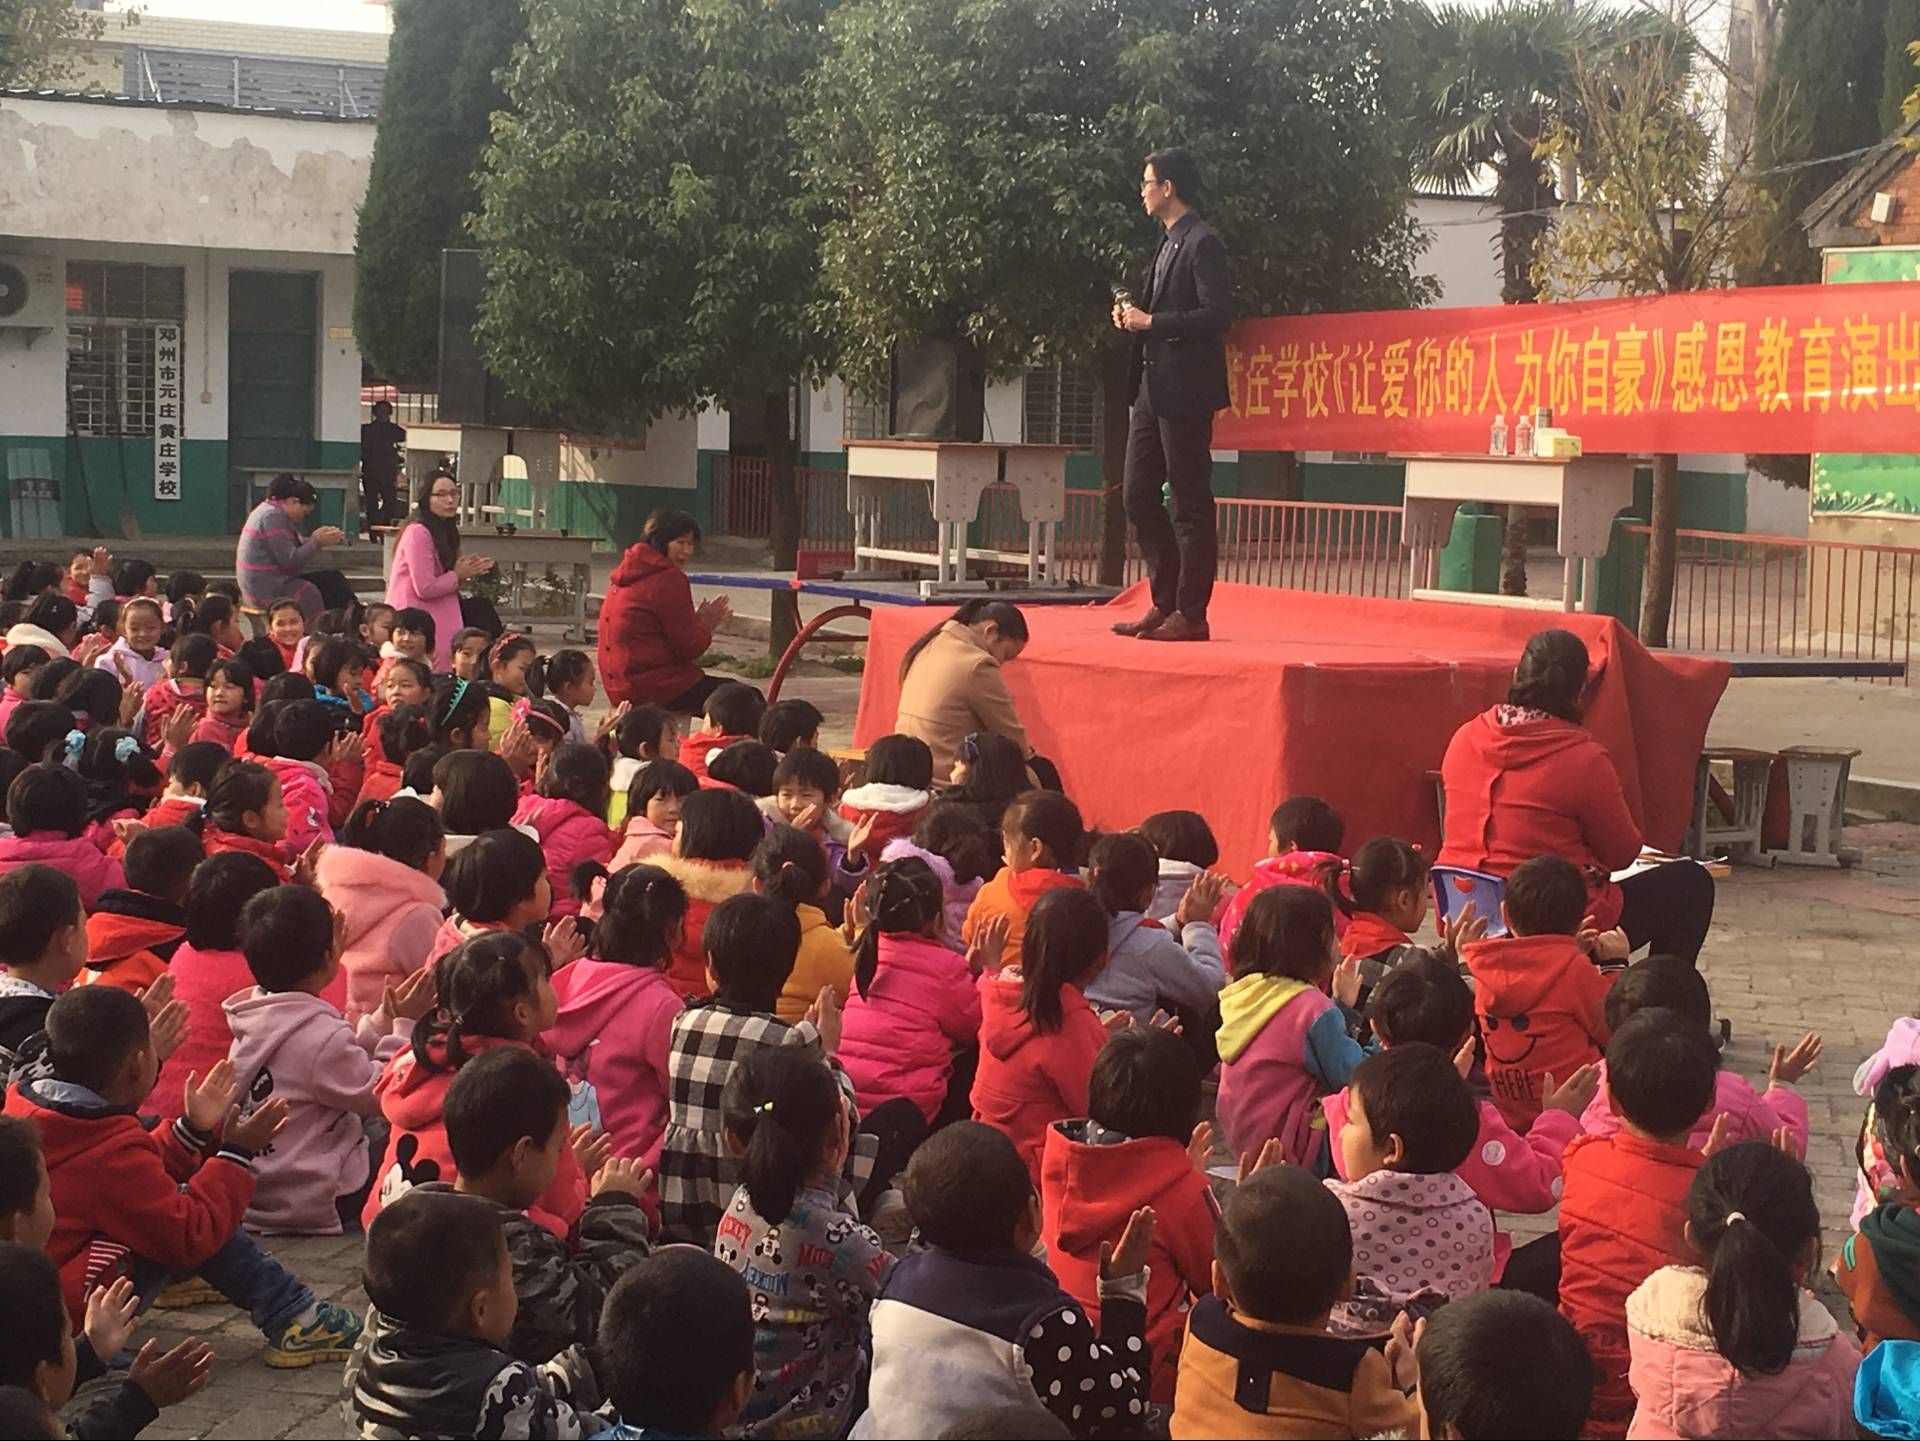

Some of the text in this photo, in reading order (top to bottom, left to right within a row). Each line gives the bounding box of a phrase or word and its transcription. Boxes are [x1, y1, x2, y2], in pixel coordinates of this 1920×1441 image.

[158, 327, 177, 496] 邓州市元庄黄庄学校
